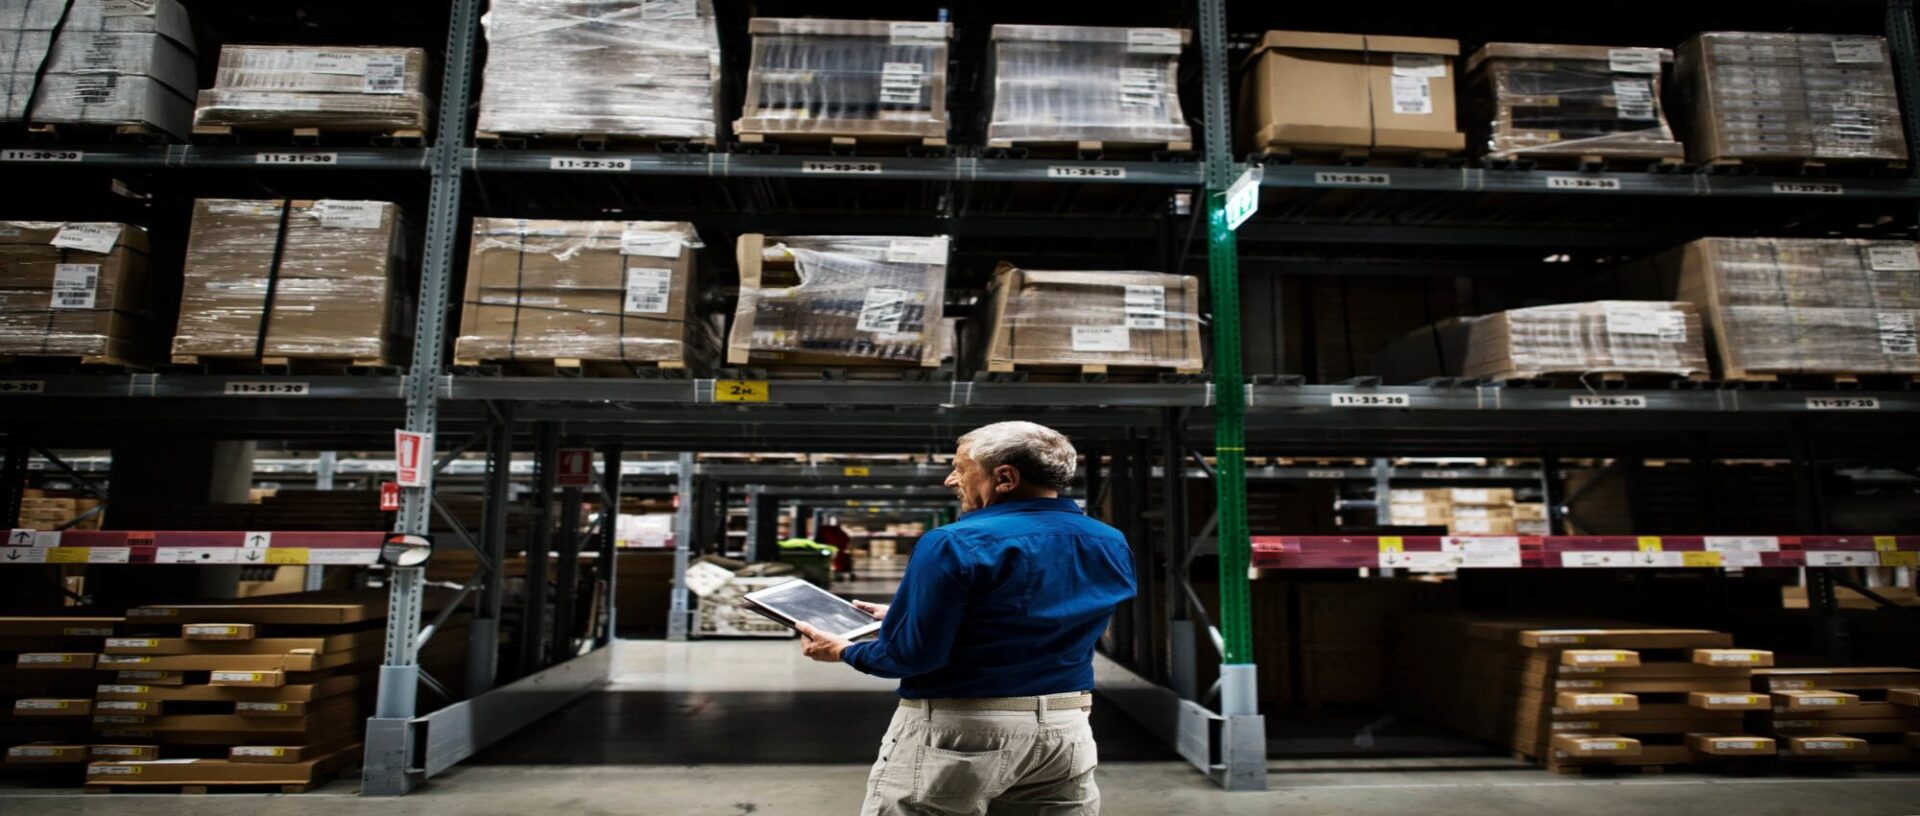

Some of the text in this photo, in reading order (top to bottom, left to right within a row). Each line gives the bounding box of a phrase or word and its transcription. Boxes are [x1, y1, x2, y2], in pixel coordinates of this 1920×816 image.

[9, 152, 77, 160] 11-20-30
[265, 154, 331, 162] 11-21-30
[559, 160, 625, 168] 11-22-30
[810, 163, 876, 171] 11-23-30
[1056, 168, 1120, 176] 11-24-30
[1322, 175, 1384, 183] 11-25-30
[233, 384, 303, 392] 11-21-20
[1339, 396, 1403, 404] 11-25-20
[1813, 399, 1874, 407] 11-27-20
[383, 492, 399, 507] 11
